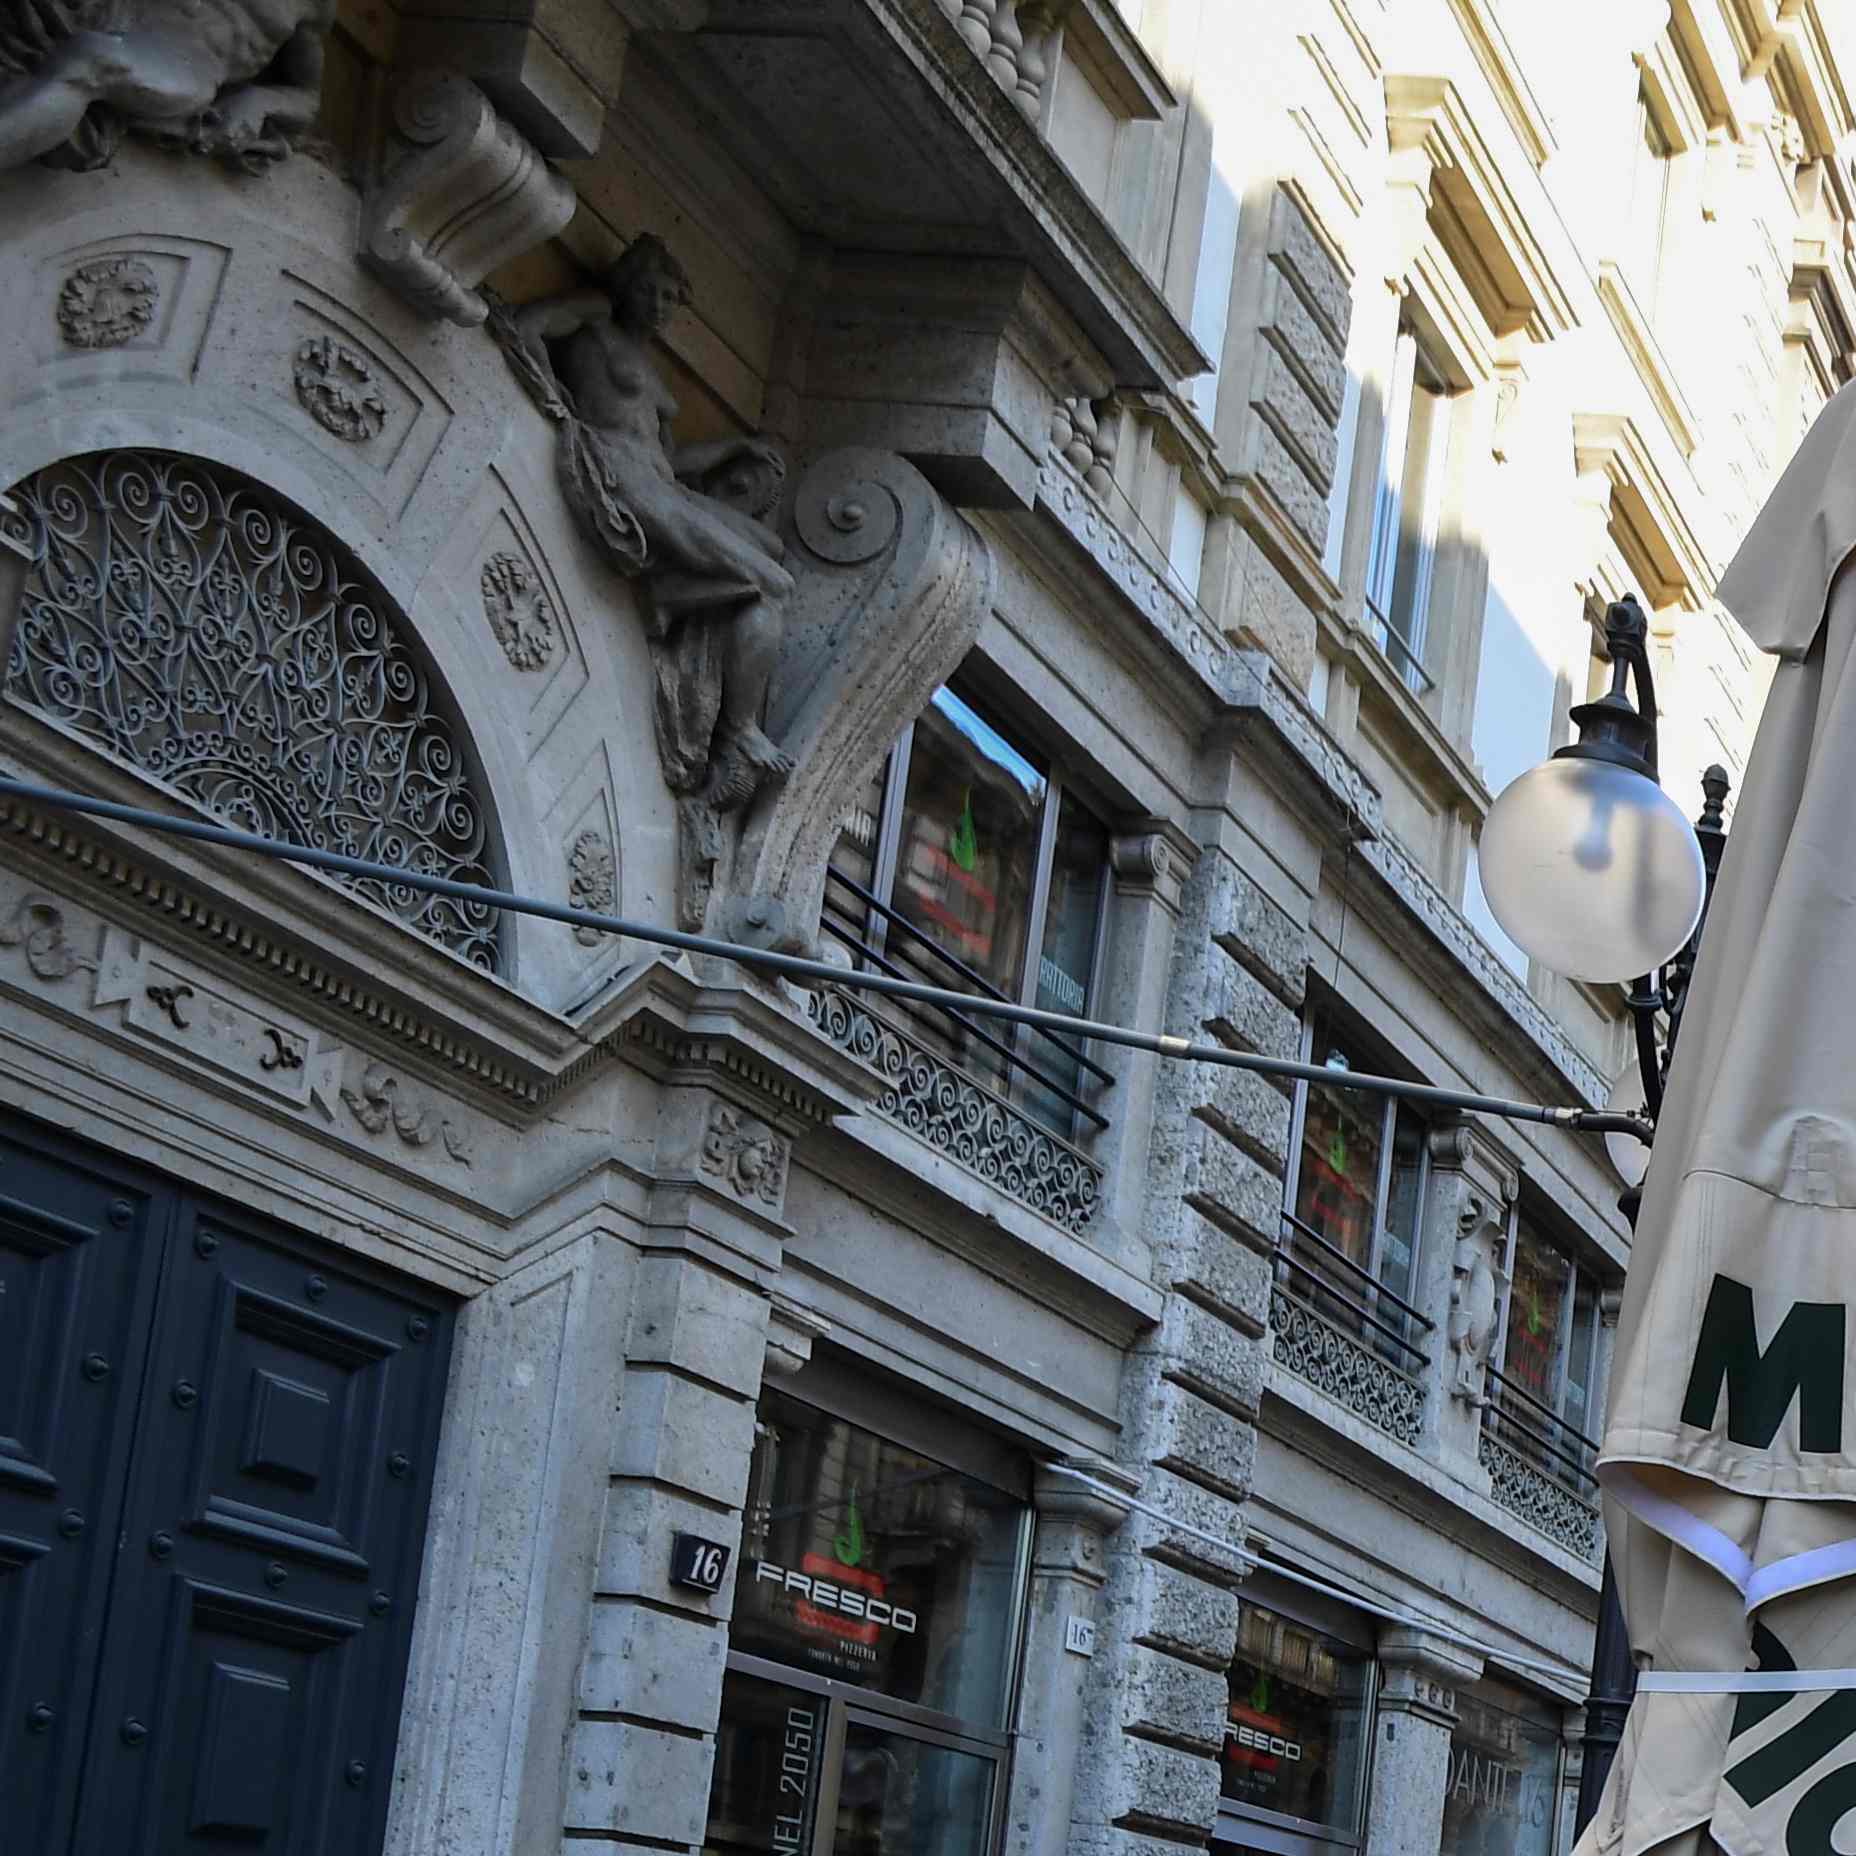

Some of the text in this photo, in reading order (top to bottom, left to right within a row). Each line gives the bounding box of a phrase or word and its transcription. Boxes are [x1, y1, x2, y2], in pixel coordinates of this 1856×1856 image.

[690, 1544, 722, 1584] 16
[756, 1561, 917, 1634] FRESCO
[780, 1707, 815, 1797] 2050
